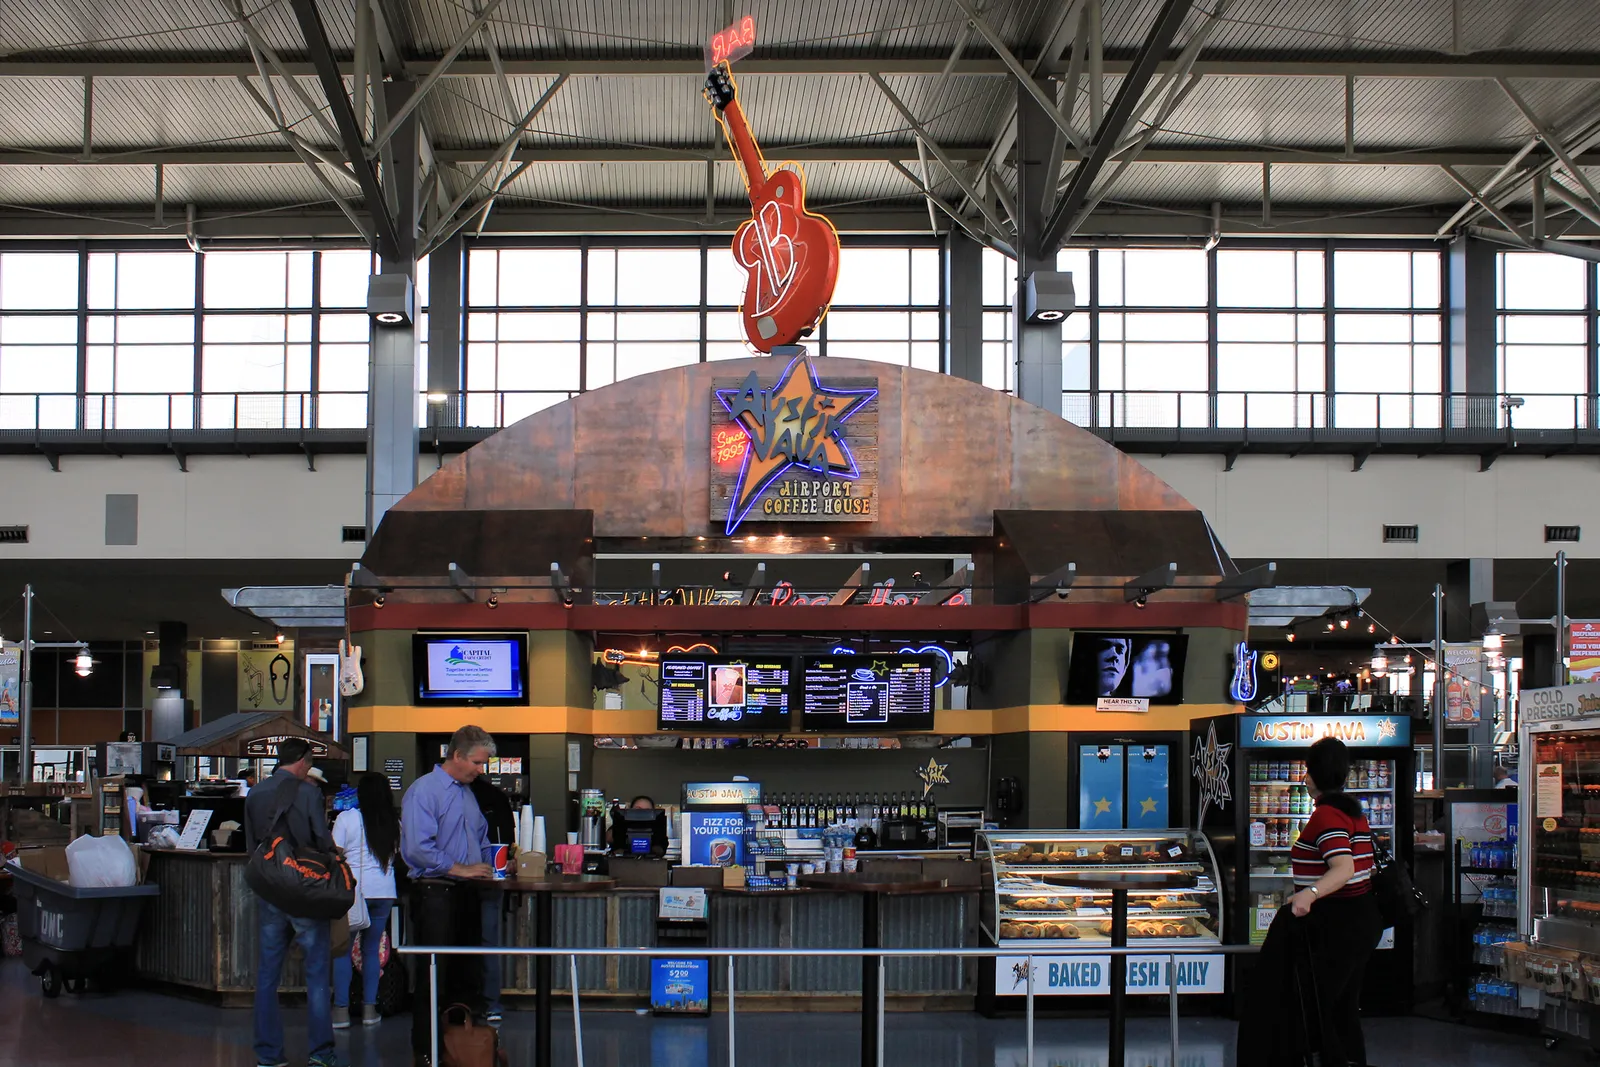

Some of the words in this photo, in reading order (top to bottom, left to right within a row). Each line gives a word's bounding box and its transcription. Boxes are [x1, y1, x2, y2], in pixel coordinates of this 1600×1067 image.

[717, 431, 746, 449] Since
[717, 441, 746, 463] 1995
[764, 499, 817, 514] COFFEE
[824, 499, 870, 514] HOUSE
[1533, 690, 1563, 706] COLD
[1526, 703, 1575, 720] PRESSED
[1253, 721, 1314, 741] AUSTIN
[1322, 721, 1366, 741] JAVA
[687, 789, 718, 798] AUSTIN
[721, 789, 743, 798] JAVA
[703, 818, 723, 826] FIZZ
[725, 818, 744, 826] FOR
[1048, 962, 1101, 987] BAKED
